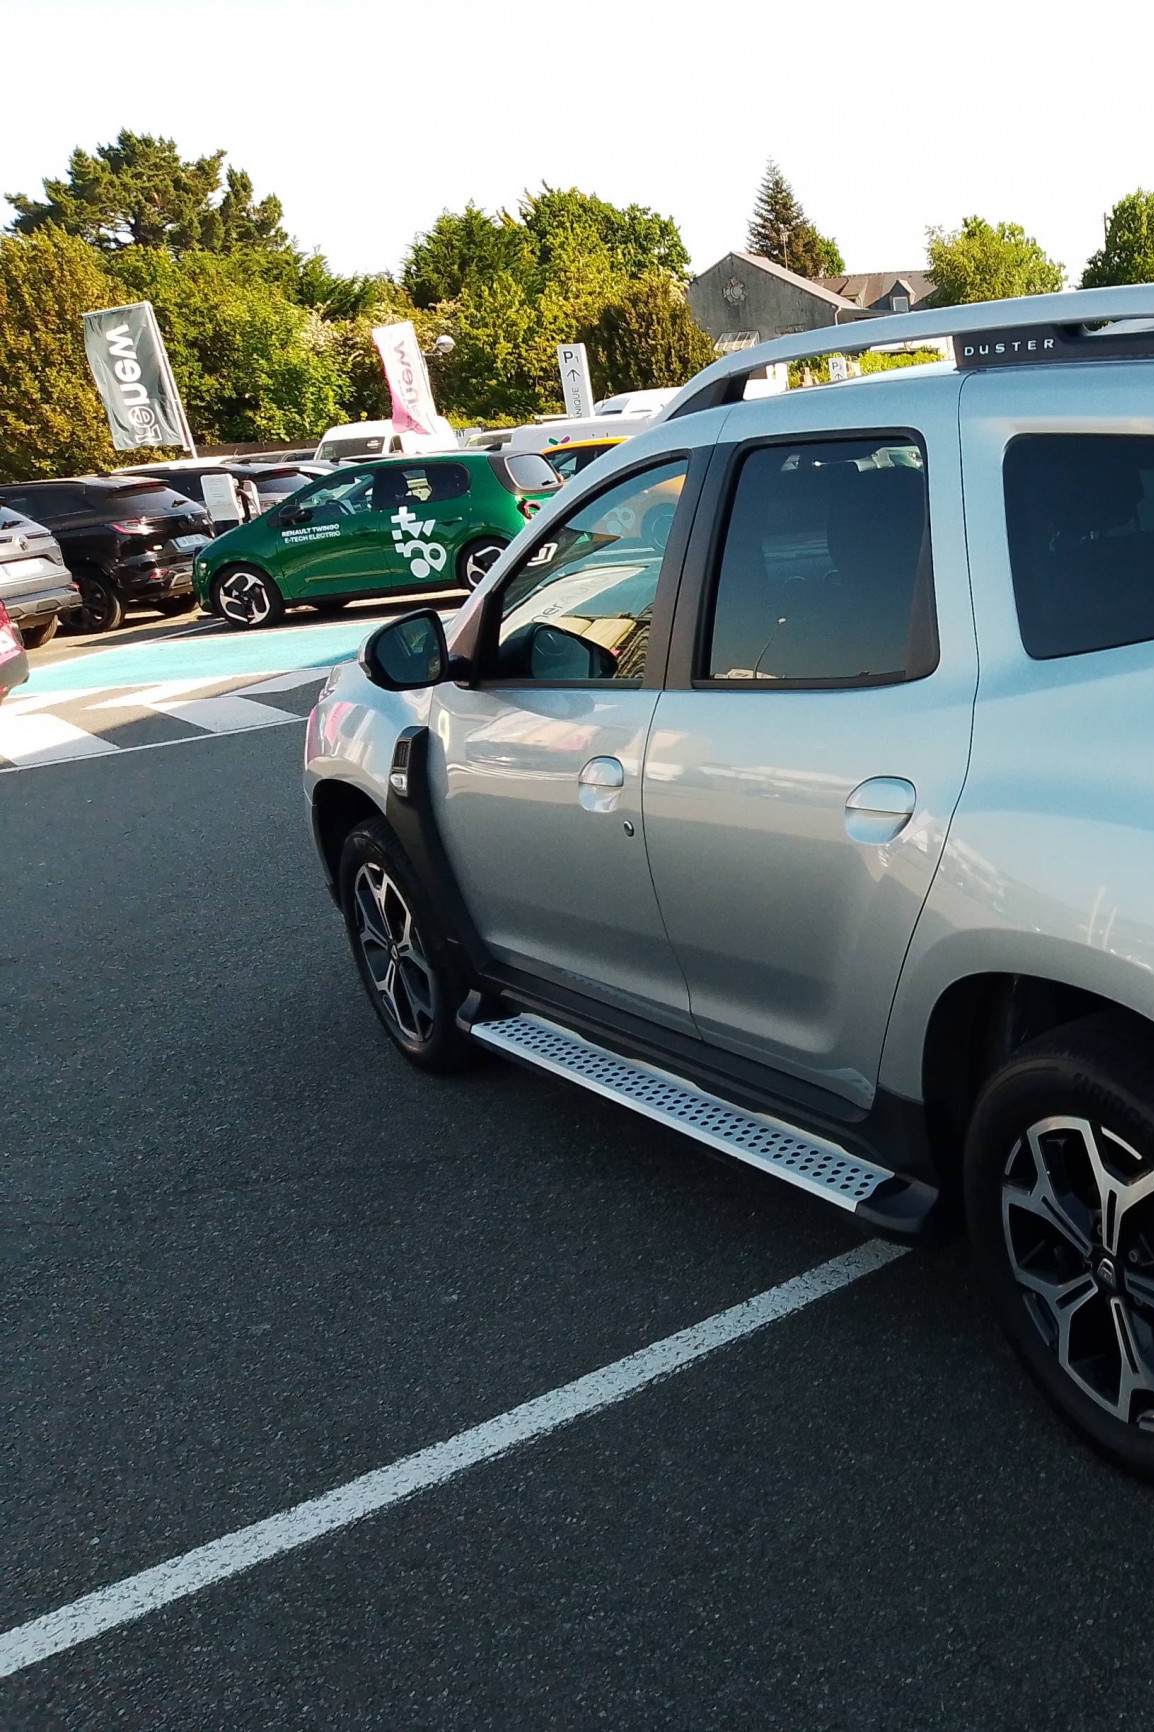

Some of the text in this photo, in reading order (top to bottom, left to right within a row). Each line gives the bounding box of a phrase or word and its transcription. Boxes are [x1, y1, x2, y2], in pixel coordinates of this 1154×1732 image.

[964, 338, 1055, 356] DUSTER
[281, 523, 340, 537] RENAULT TWINGO
[284, 530, 341, 544] E-TECH ELECTRIC
